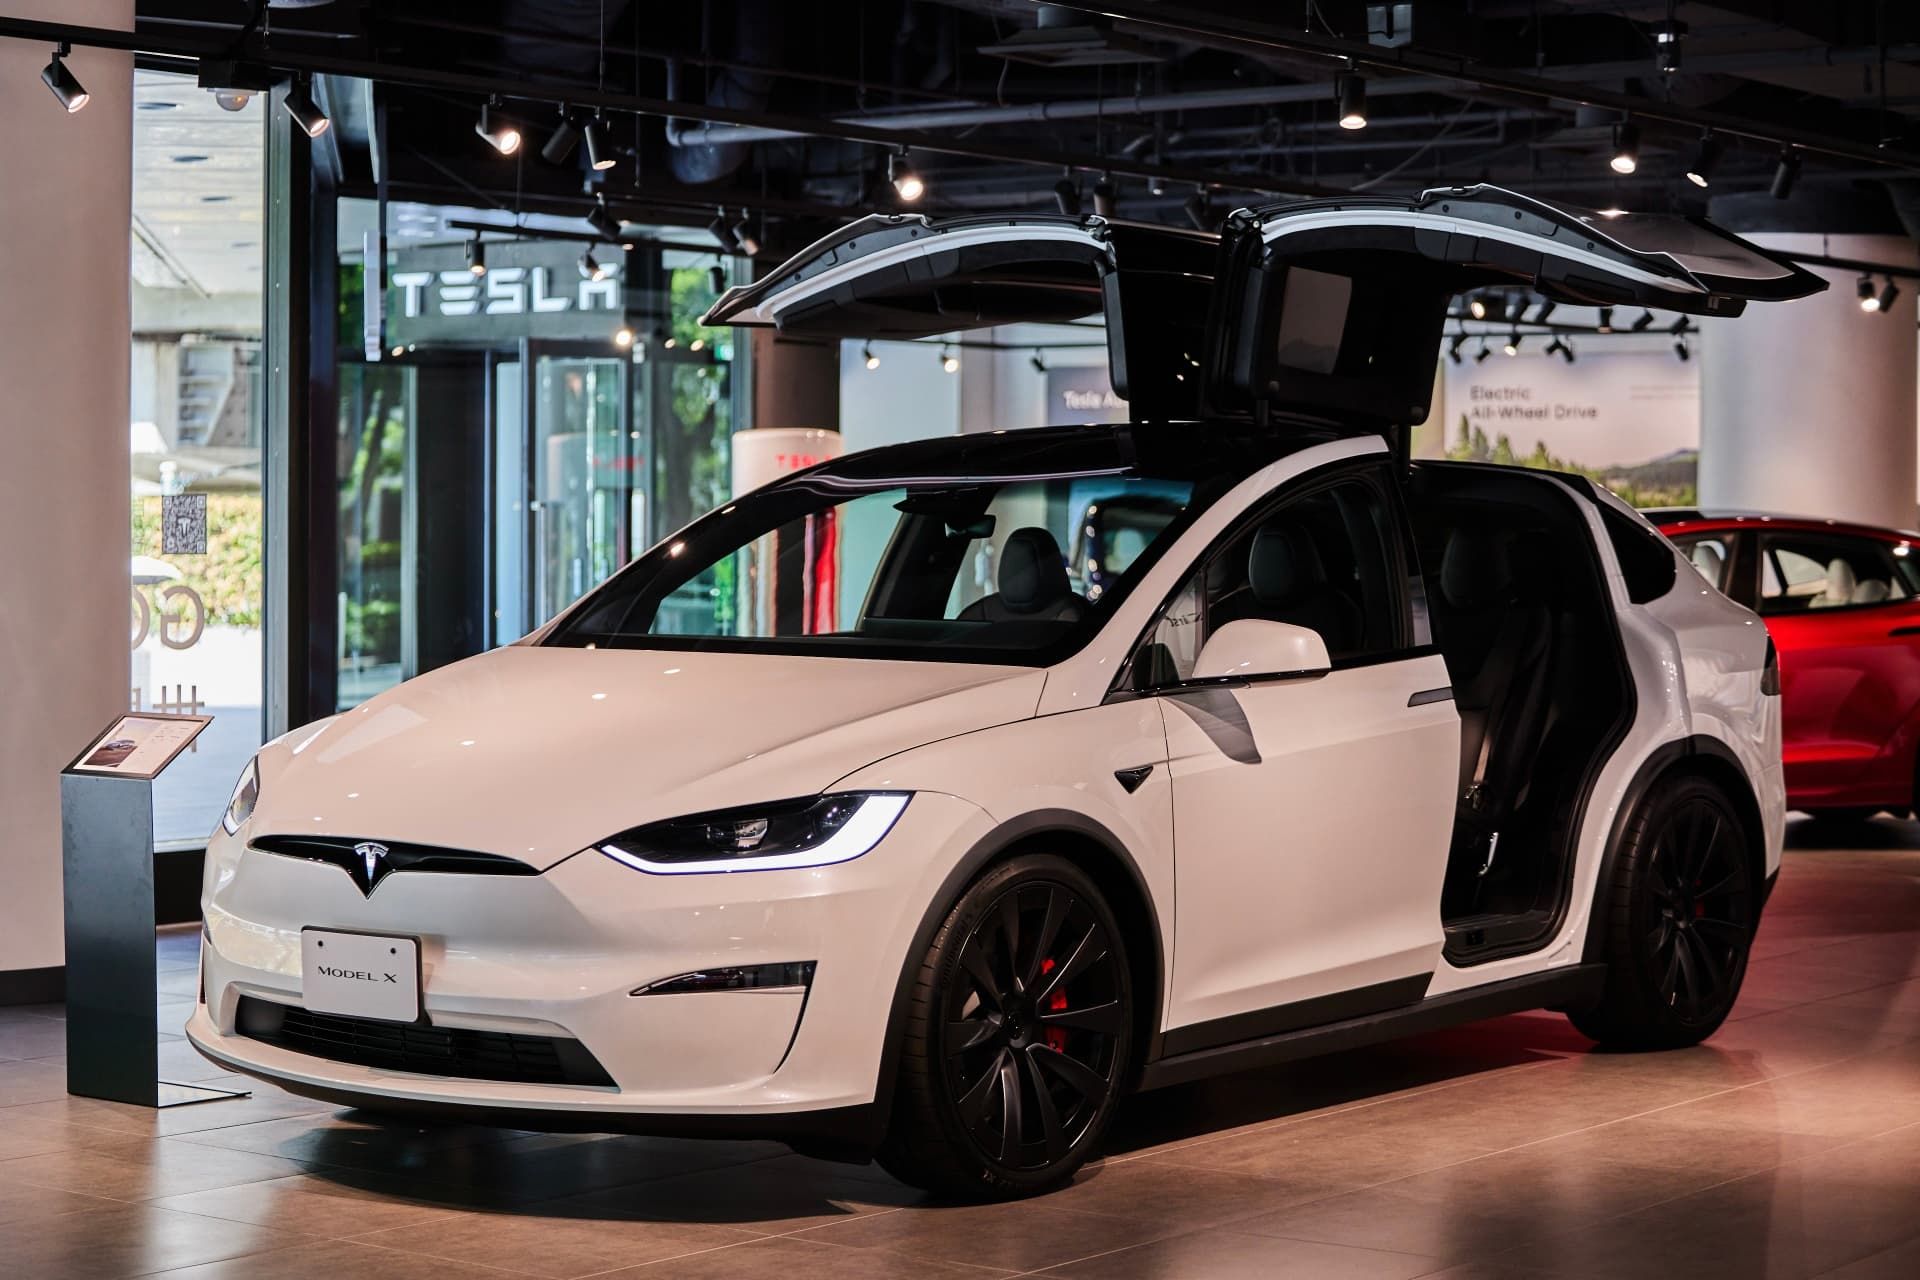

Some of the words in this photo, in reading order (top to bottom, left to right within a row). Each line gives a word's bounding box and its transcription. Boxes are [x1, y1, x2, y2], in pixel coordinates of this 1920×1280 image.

[392, 262, 619, 317] TESLA
[1063, 390, 1102, 409] Tesla
[1471, 385, 1531, 400] Electric
[1471, 405, 1549, 419] All-Wheel
[1554, 405, 1598, 419] Drive
[318, 965, 380, 982] MODEL
[384, 973, 397, 984] X
